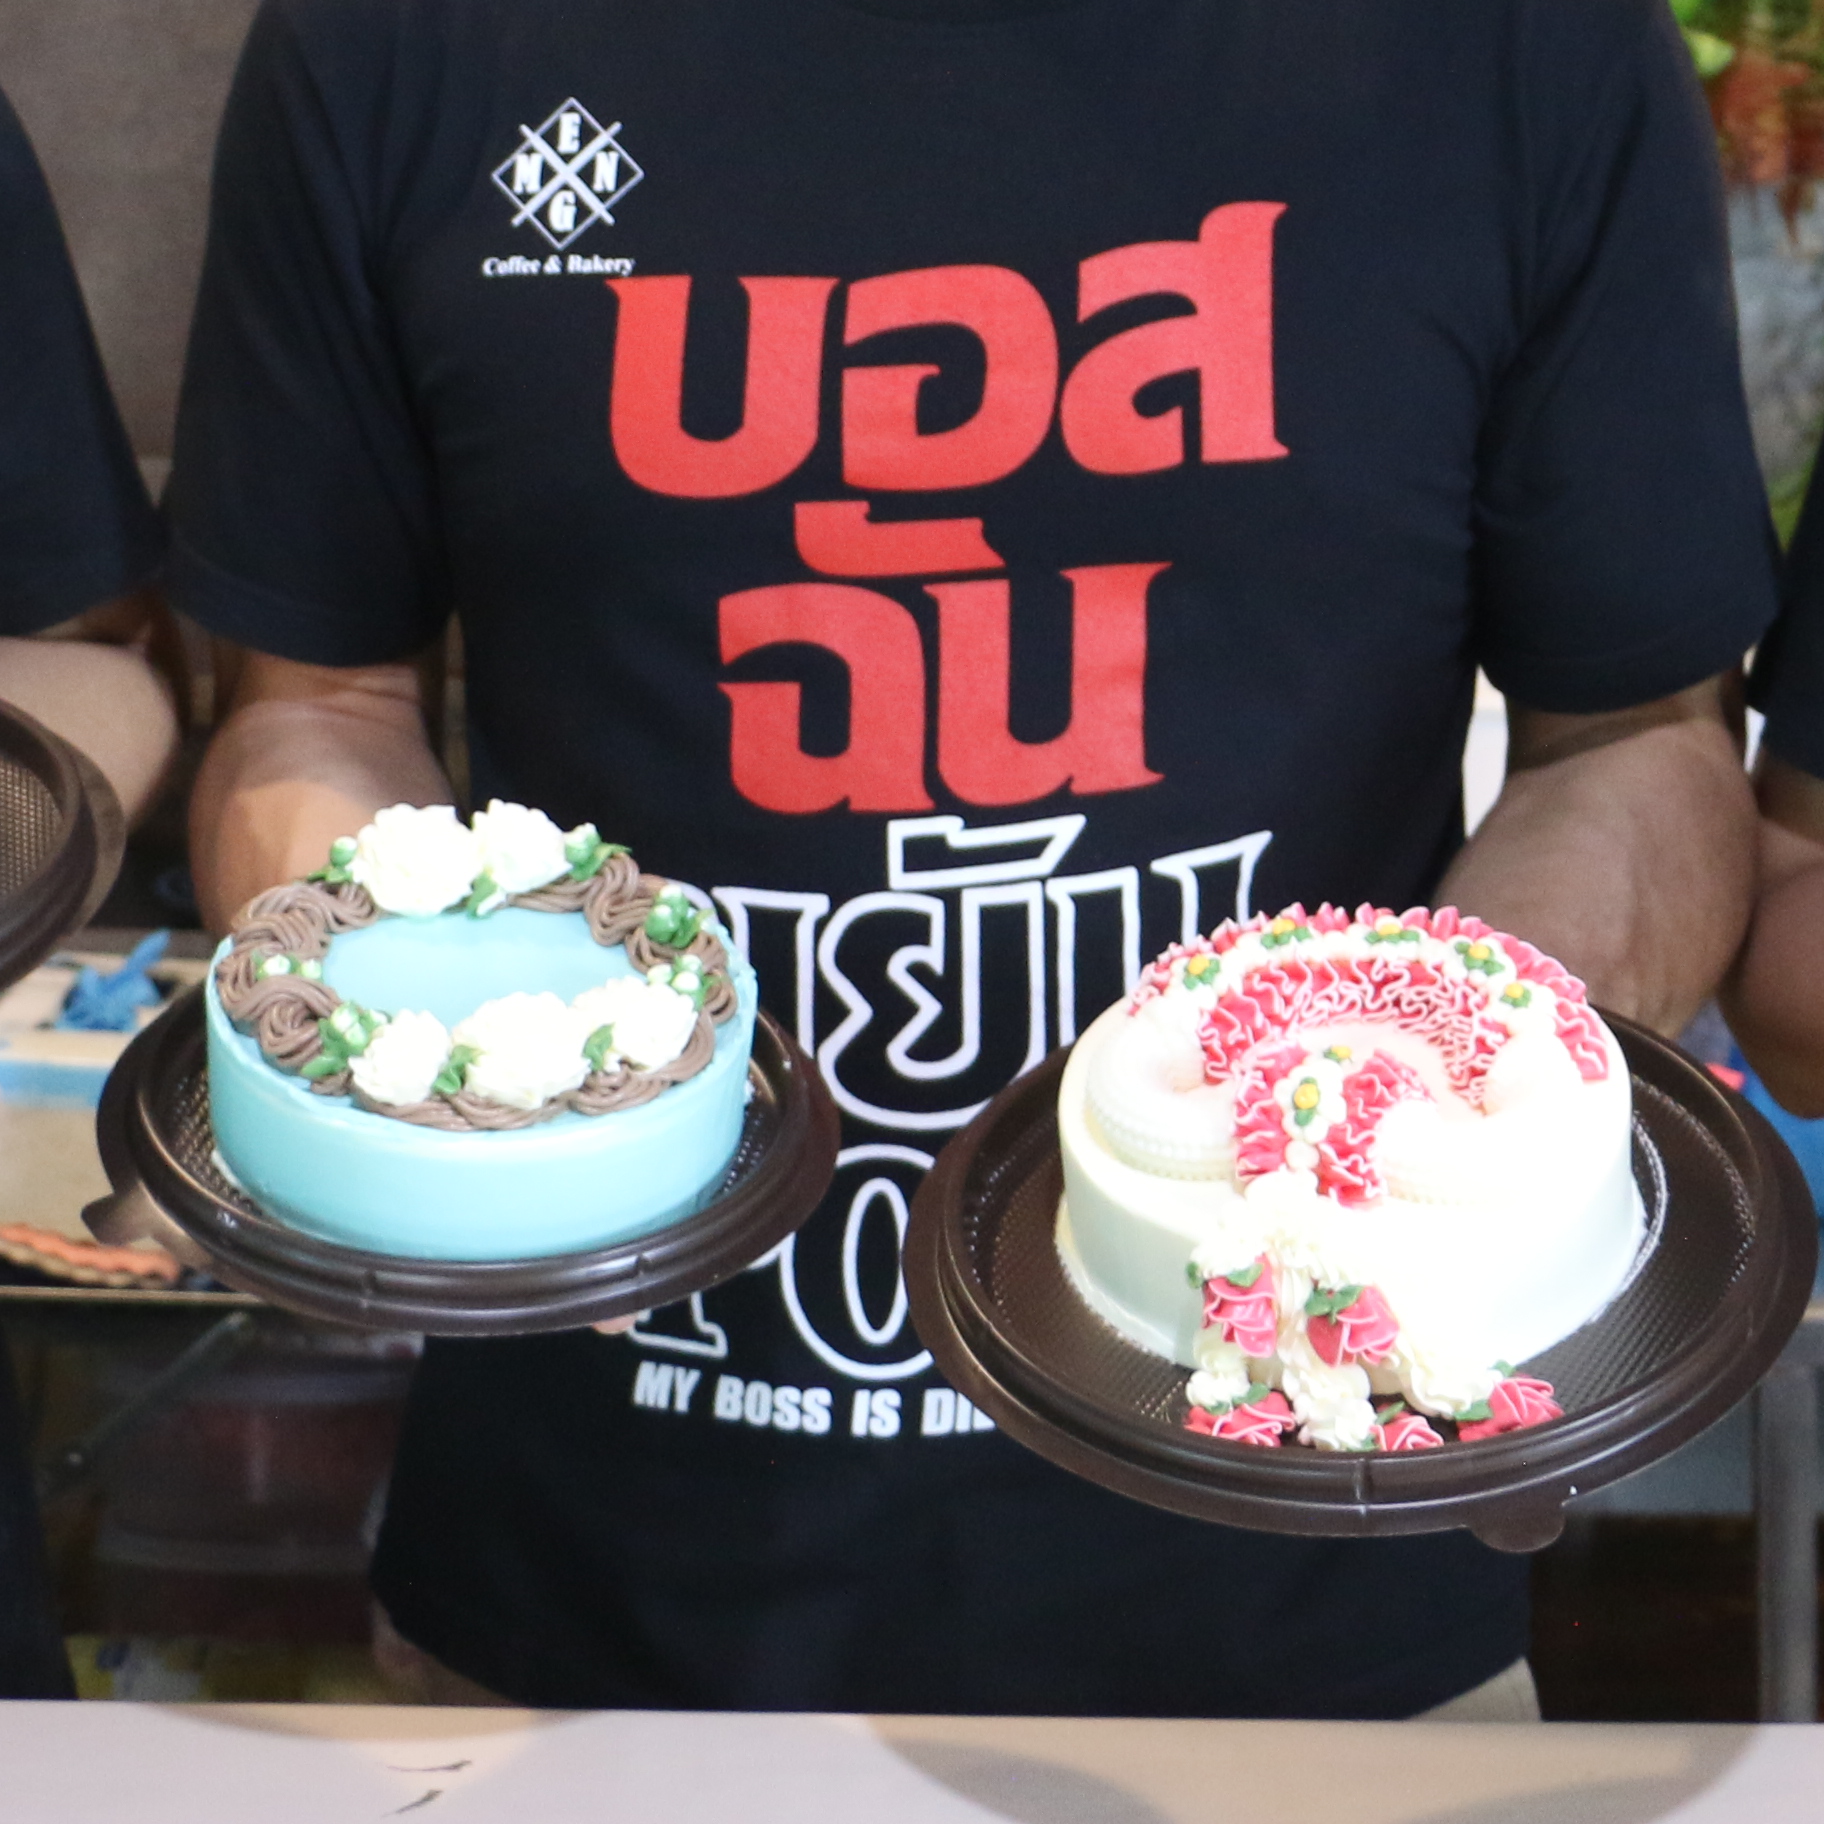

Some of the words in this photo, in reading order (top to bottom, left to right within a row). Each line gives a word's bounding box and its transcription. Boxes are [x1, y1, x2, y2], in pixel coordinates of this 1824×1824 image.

[482, 256, 542, 278] Coffee
[543, 253, 563, 275] &
[566, 253, 637, 278] Bakery
[604, 200, 1290, 500] บอส
[716, 499, 1173, 816] ฉัน
[633, 1360, 702, 1414] MY
[713, 1374, 833, 1436] BOSS
[850, 1387, 903, 1439] IS
